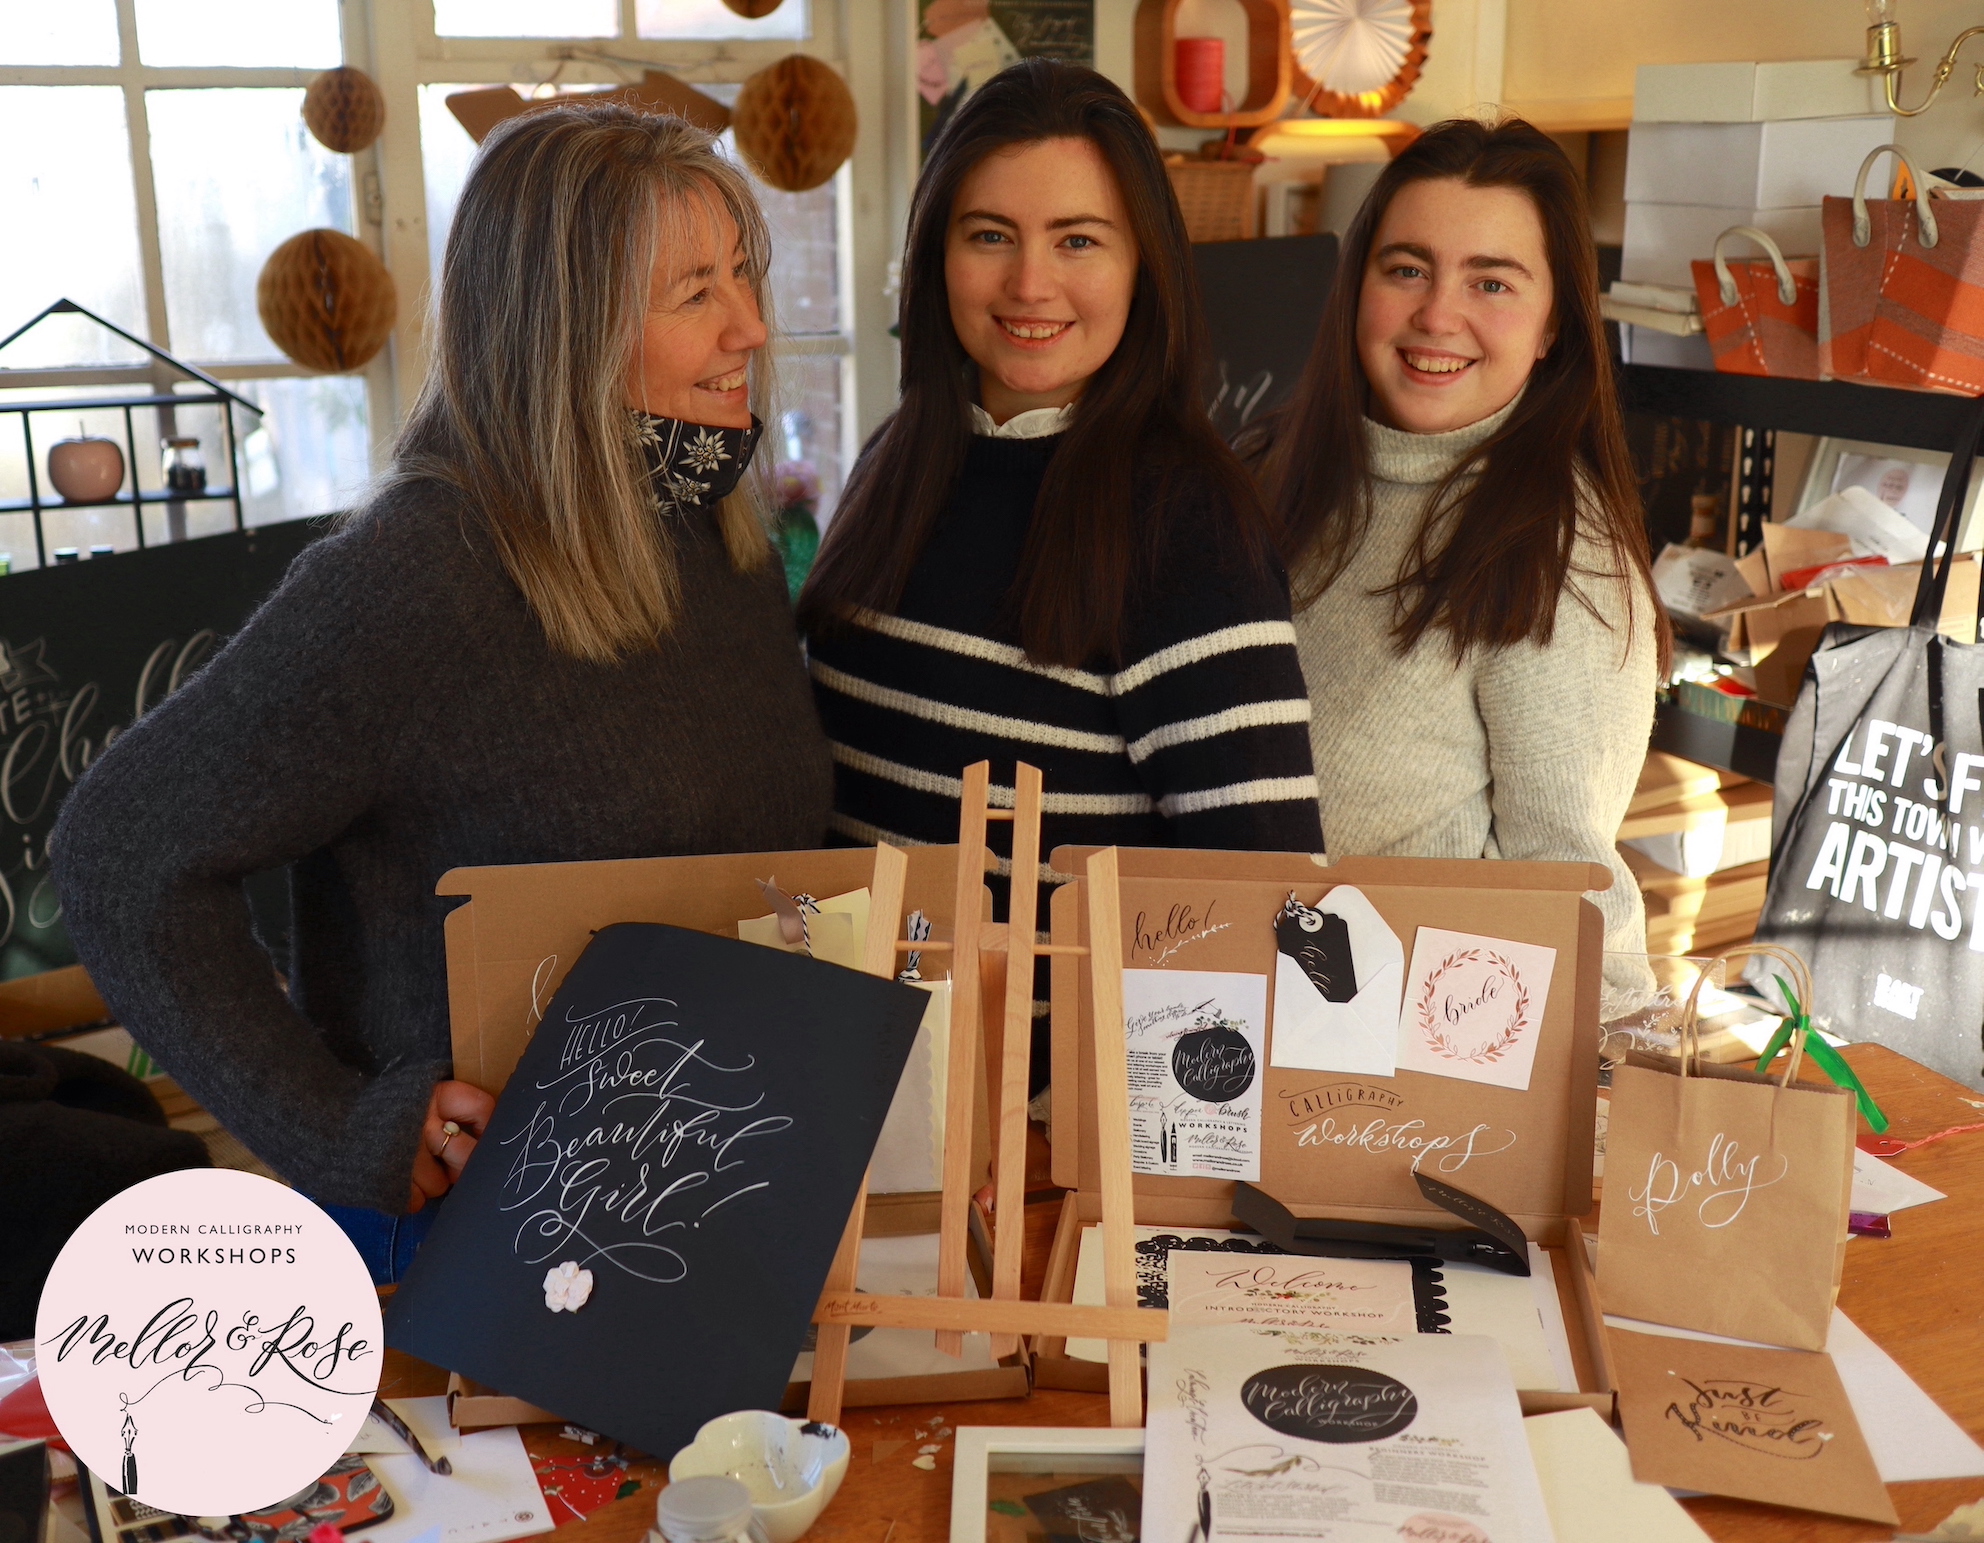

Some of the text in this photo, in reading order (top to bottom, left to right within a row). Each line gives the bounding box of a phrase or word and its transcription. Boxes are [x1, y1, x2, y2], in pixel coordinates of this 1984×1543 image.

[1827, 777, 1888, 827] THIS
[1131, 900, 1217, 960] hello!
[1443, 978, 1504, 1027] bride
[560, 1005, 645, 1070] HELLO!
[1175, 1037, 1225, 1074] Modern
[559, 1038, 754, 1116] Sweet
[1184, 1045, 1255, 1091] Calligraphy
[1179, 1122, 1247, 1133] WORKSHOPS
[1219, 1103, 1251, 1121] brush
[500, 1093, 793, 1210] Beautiful
[1293, 1120, 1517, 1173] Workshops
[1205, 1266, 1378, 1291] Welcome
[1311, 1309, 1384, 1319] WORKSHOP
[1247, 1374, 1349, 1405] Modern
[1264, 1384, 1416, 1427] Calligraphy
[1665, 1402, 1823, 1456] Kind
